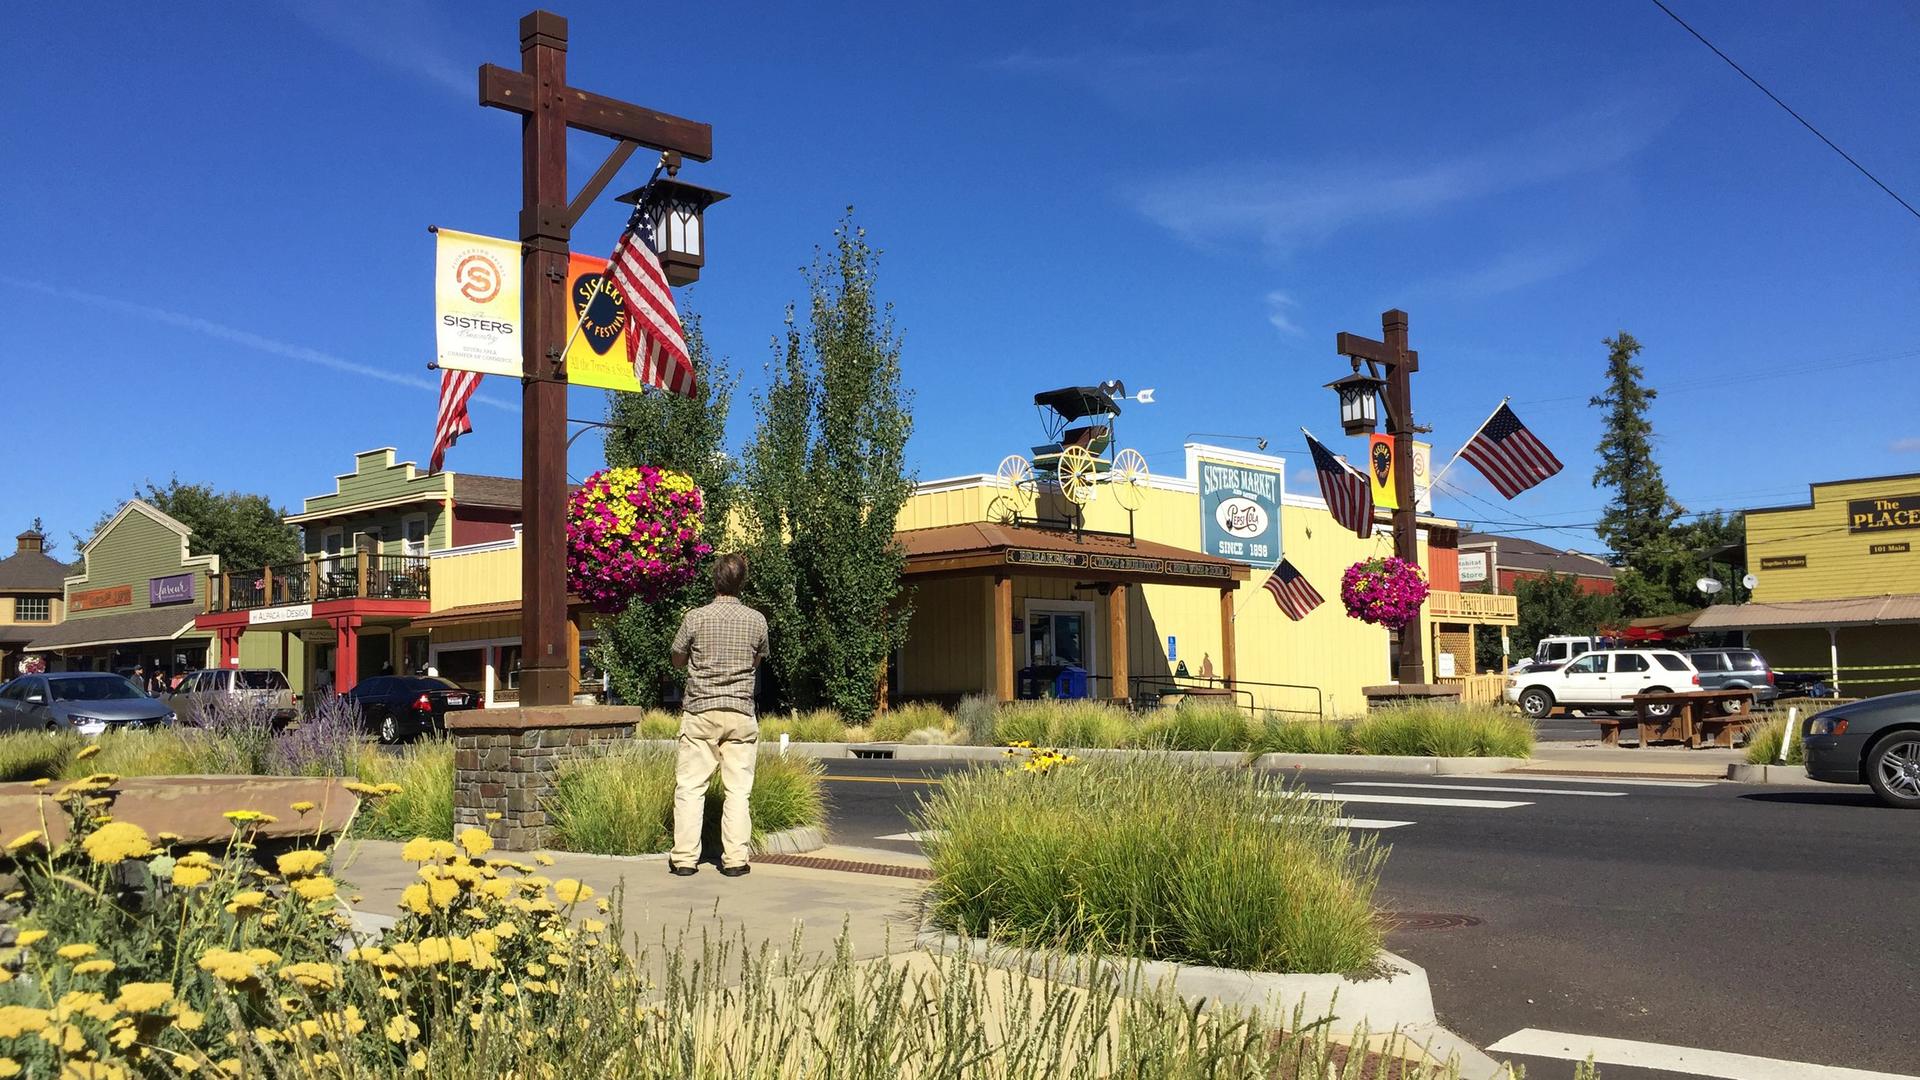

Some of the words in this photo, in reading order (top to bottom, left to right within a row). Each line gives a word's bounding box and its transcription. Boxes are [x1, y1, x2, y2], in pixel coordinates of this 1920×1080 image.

[443, 314, 514, 334] SISTERS
[594, 310, 625, 338] FESTIVAL
[1204, 465, 1239, 496] SISTERS
[1240, 470, 1276, 504] MARKET
[1874, 500, 1900, 511] The
[1854, 509, 1920, 528] PLACE
[1219, 540, 1244, 555] SINCE
[1888, 544, 1906, 552] Main
[1019, 550, 1077, 566] BREAKFAST
[1461, 570, 1484, 579] Store
[286, 608, 309, 618] DESIGN
